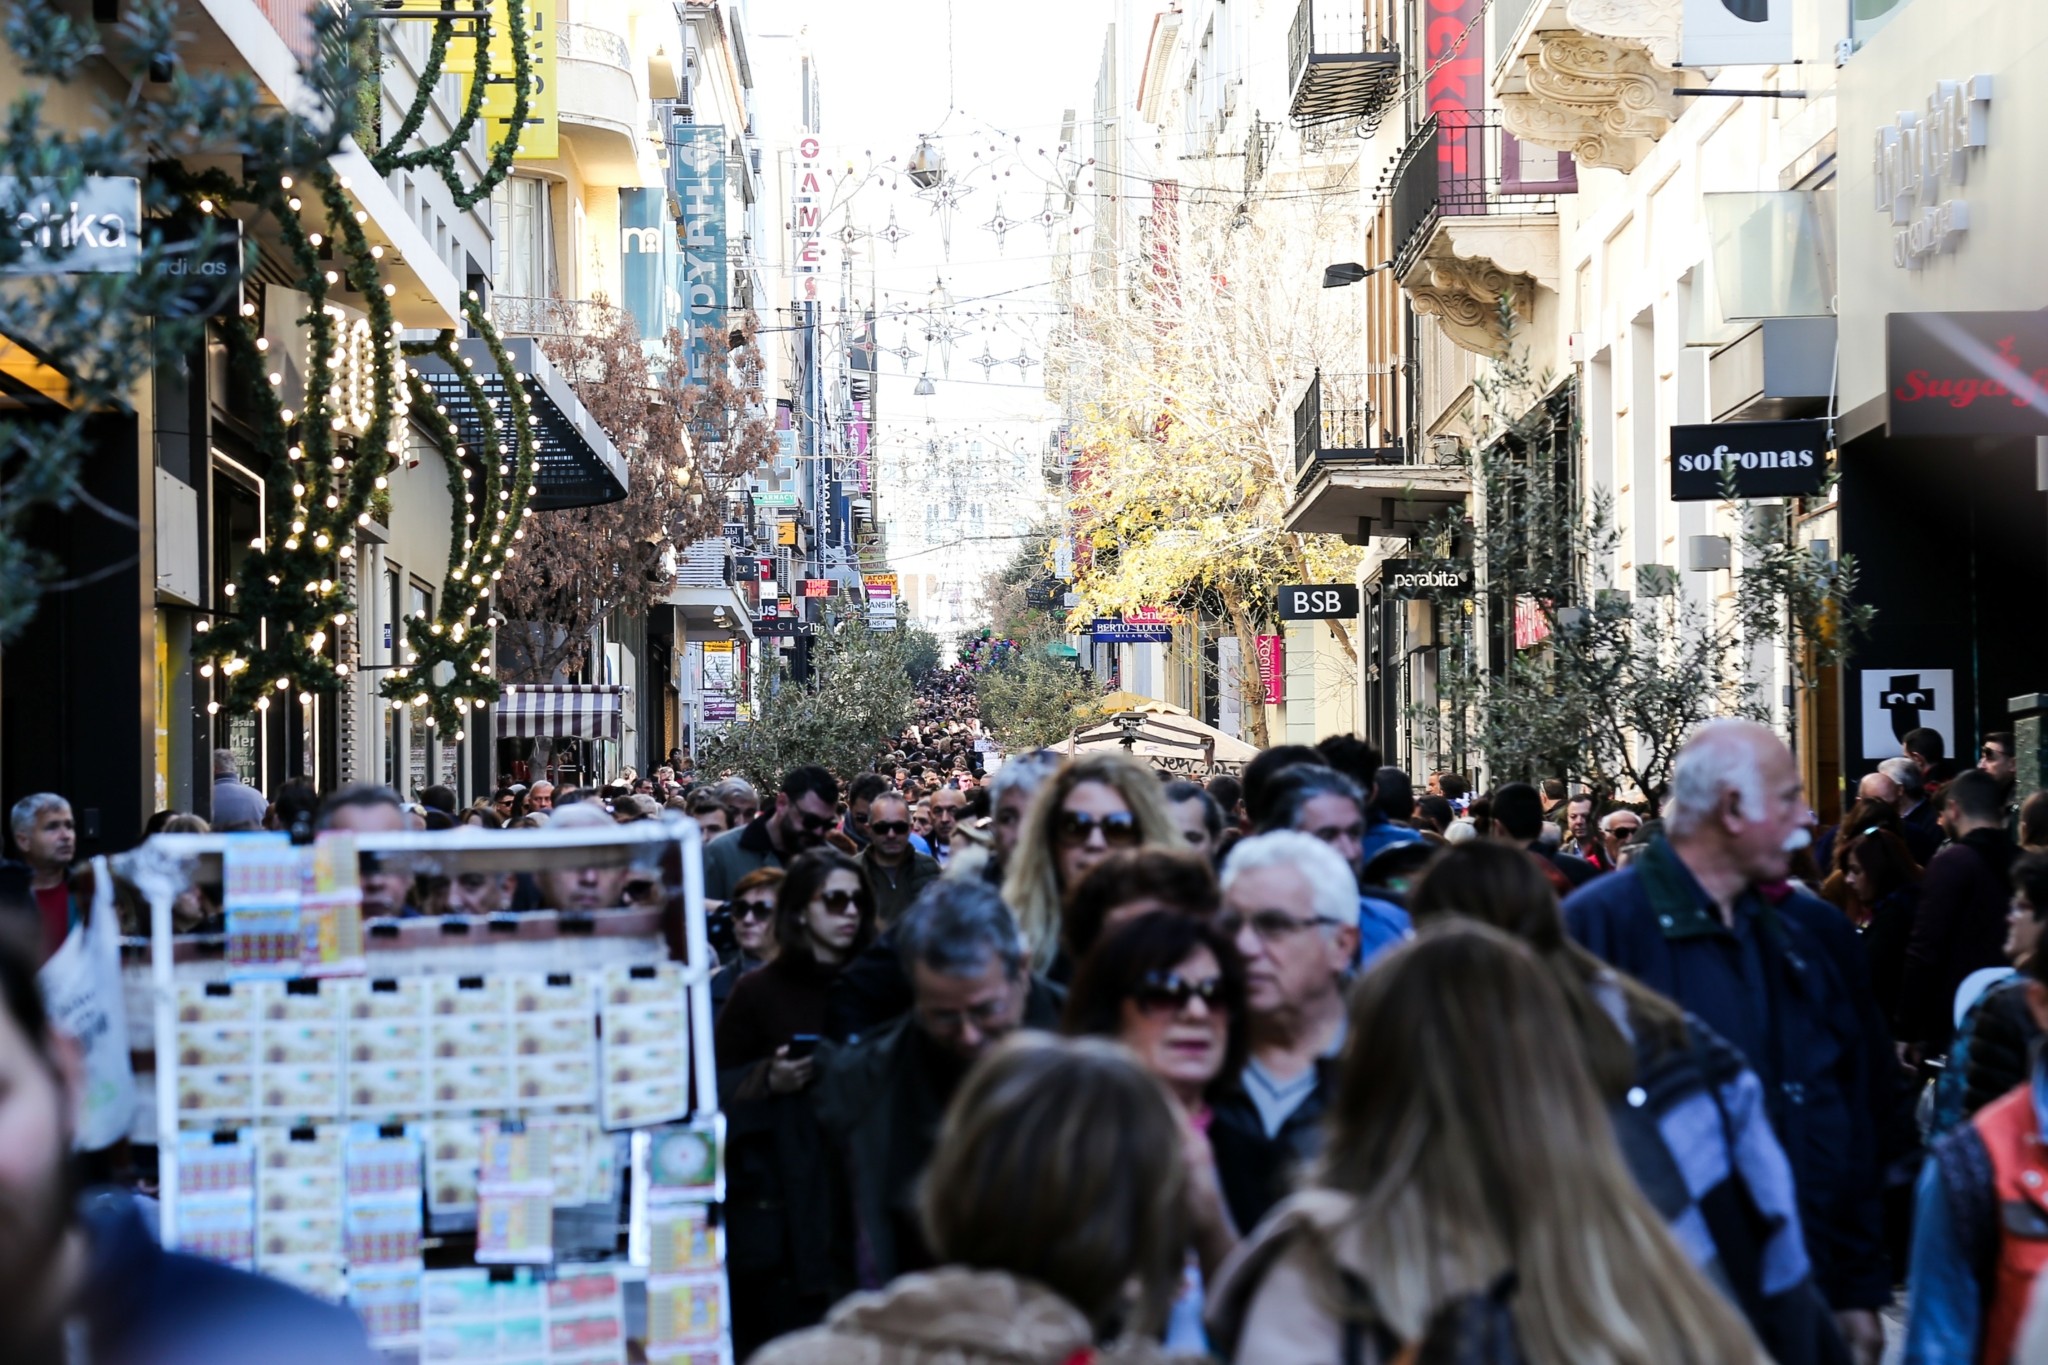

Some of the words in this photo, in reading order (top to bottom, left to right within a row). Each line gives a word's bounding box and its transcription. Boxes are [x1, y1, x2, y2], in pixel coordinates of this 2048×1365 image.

[1428, 0, 1482, 174] cker
[1678, 445, 1814, 472] sofronas
[1394, 571, 1459, 589] parabita
[1294, 591, 1341, 613] BSB
[1097, 623, 1130, 632] BERTO
[1136, 623, 1167, 632] LUCCI
